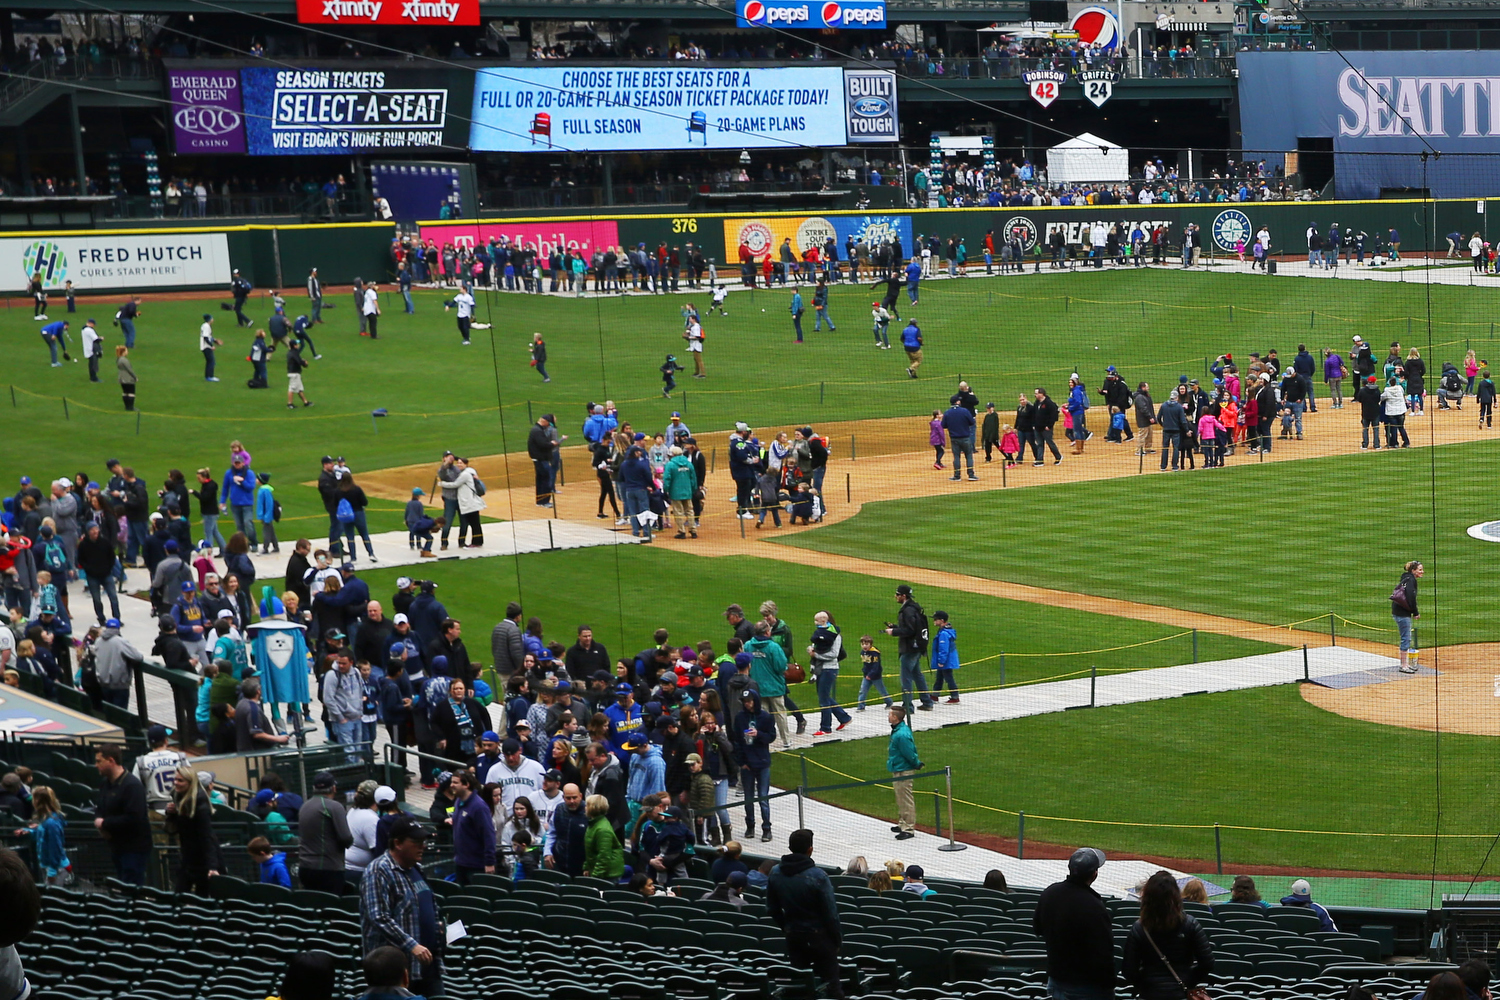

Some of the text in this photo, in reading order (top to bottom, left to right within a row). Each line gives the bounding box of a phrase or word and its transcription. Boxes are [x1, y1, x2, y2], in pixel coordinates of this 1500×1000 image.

[322, 0, 460, 22] xfinity xfinity
[767, 5, 884, 25] pepsi pepsi
[1168, 22, 1208, 31] CLUBHOUSE
[171, 76, 237, 89] EMERALD
[275, 71, 385, 88] SEASON TICKETS
[562, 70, 751, 88] CHOOSE THE BEST SEATS FOR A
[1026, 71, 1065, 81] ROBINSON
[1082, 71, 1115, 80] GRIFFEY
[849, 77, 891, 96] BUILT
[1036, 83, 1054, 98] 42
[1090, 82, 1107, 98] 24
[183, 89, 227, 101] QUEEN
[480, 88, 829, 108] FULL OR 20-GAME PLAN SEASON TICKET PACKAGE TODAY!
[278, 94, 441, 122] SELECT-A-SEAT
[860, 100, 882, 112] Ford
[183, 108, 236, 134] EQC
[562, 118, 642, 135] FULL SEASON
[717, 116, 806, 133] 20-GAME PLANS
[851, 118, 893, 133] TOUGH
[191, 139, 229, 147] CASINO
[272, 131, 443, 148] VISIT EDGAR'S HOME RUN PORCH
[672, 218, 698, 234] 376
[79, 246, 202, 263] FRED HUTCH
[80, 267, 114, 278] CURES
[116, 266, 146, 276] START
[155, 770, 175, 793] 15
[497, 776, 535, 788] MARINERS
